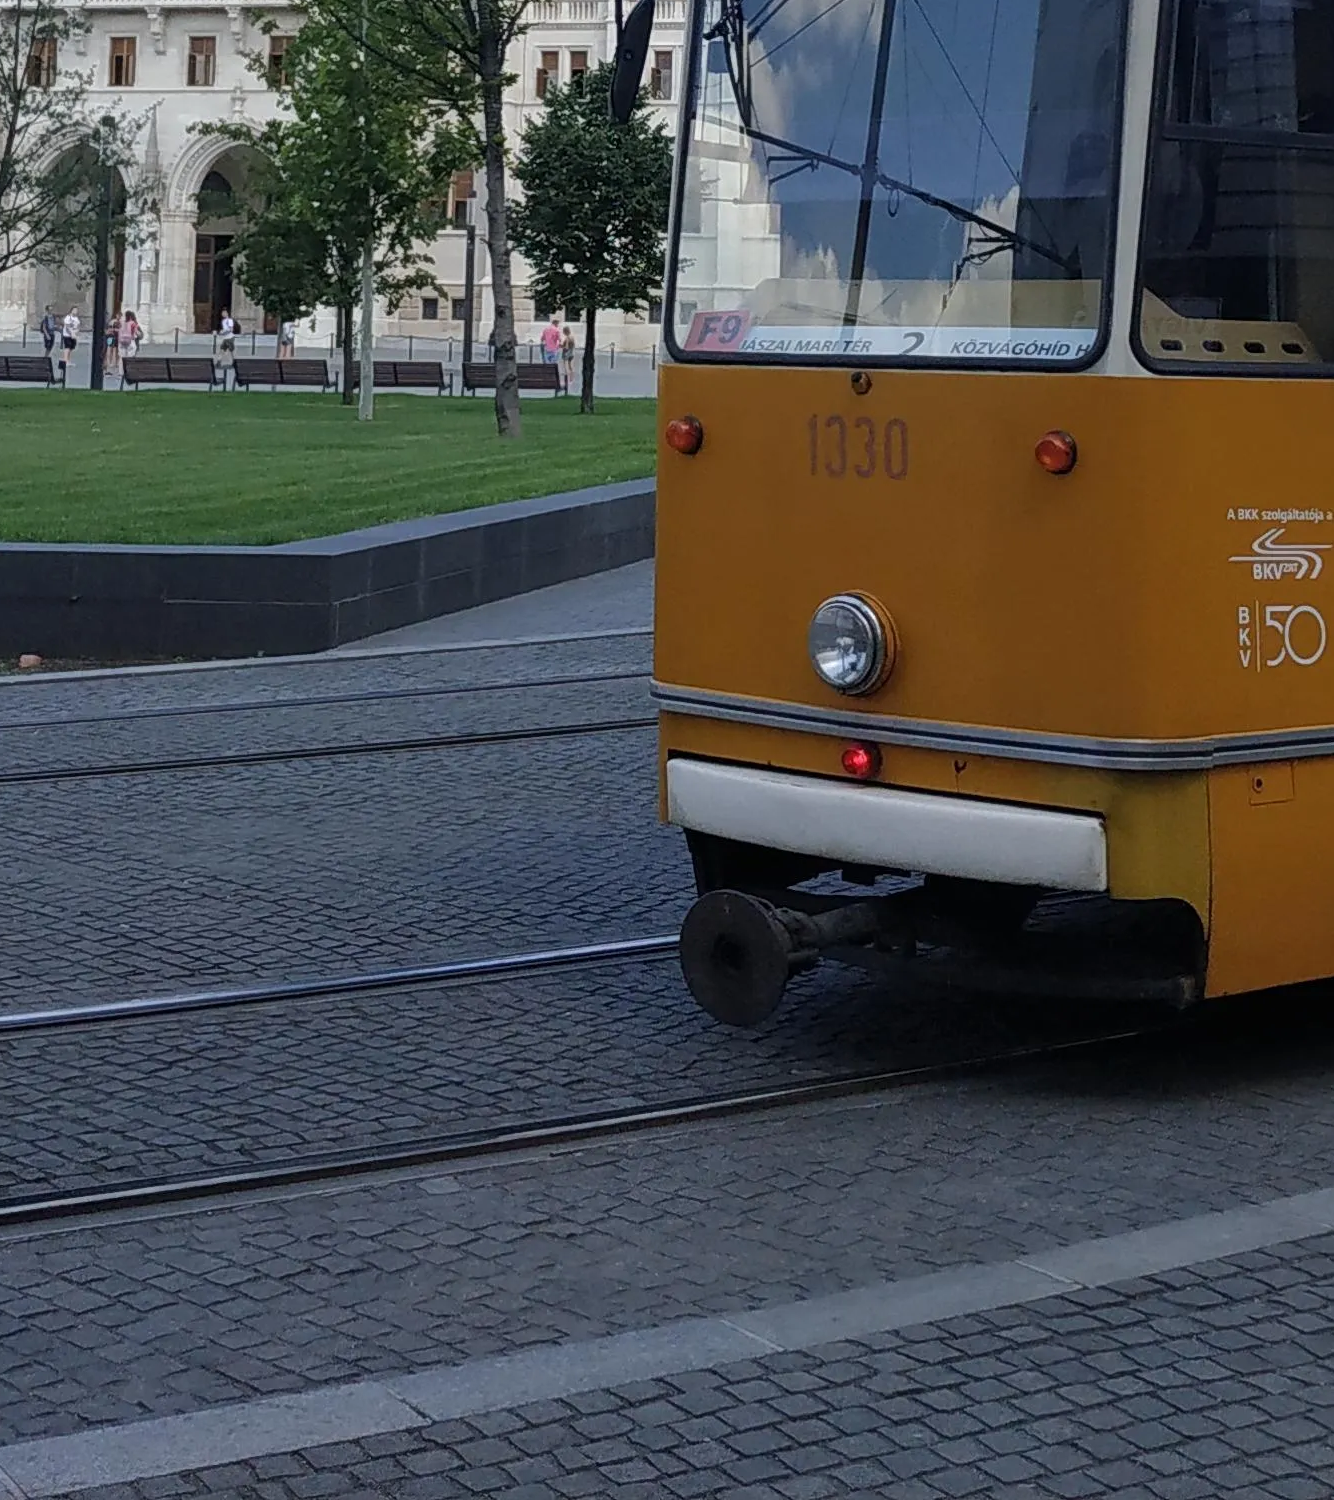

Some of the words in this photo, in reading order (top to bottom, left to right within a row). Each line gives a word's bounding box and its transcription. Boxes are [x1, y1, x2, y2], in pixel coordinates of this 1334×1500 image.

[697, 315, 743, 345] F9
[842, 337, 873, 353] TÉR
[899, 331, 925, 355] 2
[950, 338, 1071, 356] KÖZVÁGÓHÍD
[808, 413, 909, 481] 1330
[1227, 508, 1236, 520] A
[1237, 508, 1259, 521] BKK
[1261, 508, 1324, 524] szolgáltatója
[1326, 511, 1333, 521] a
[1265, 605, 1327, 667] 50
